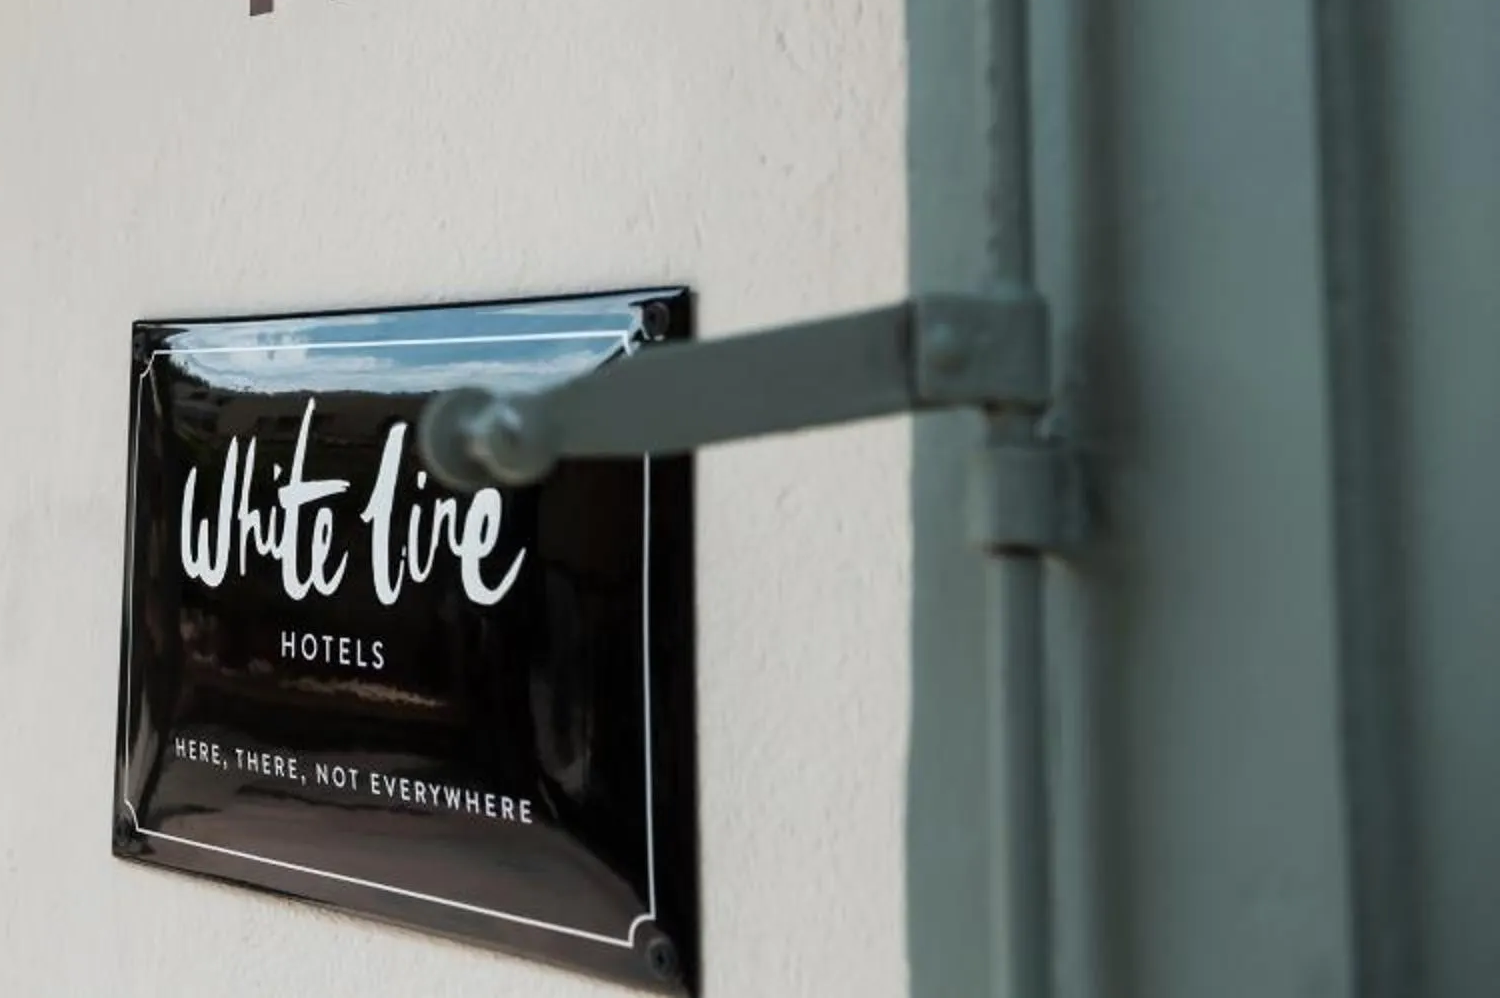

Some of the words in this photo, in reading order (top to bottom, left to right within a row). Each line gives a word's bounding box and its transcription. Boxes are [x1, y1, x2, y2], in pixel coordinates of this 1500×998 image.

[180, 396, 351, 601] White
[280, 630, 385, 670] HOTELS
[174, 736, 228, 770] HERE,
[234, 748, 307, 786] THERE,
[315, 762, 360, 791] NOT
[370, 772, 534, 824] EVERYWHERE
